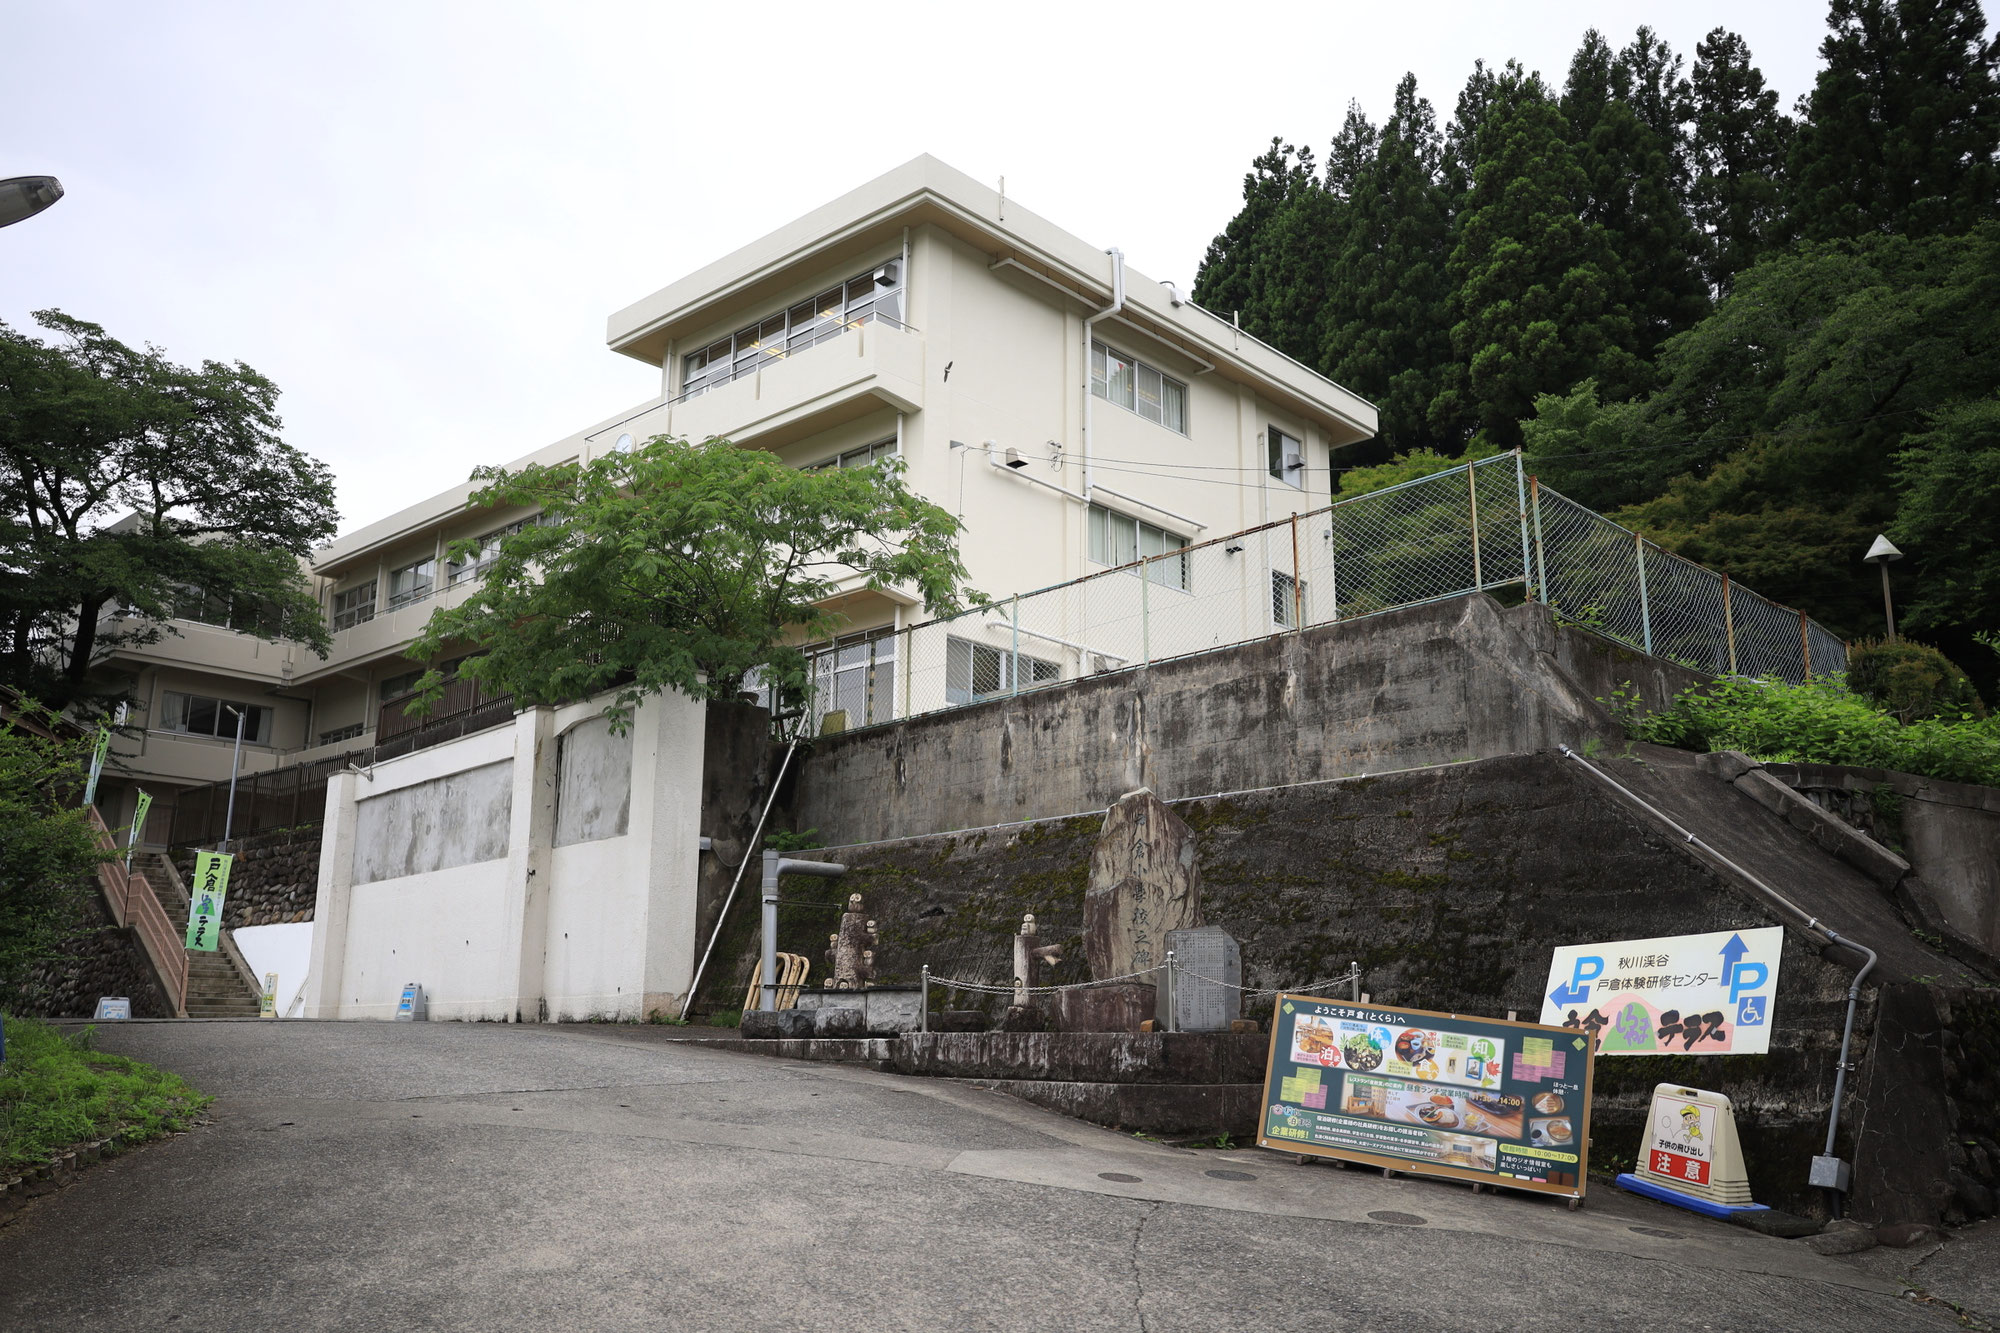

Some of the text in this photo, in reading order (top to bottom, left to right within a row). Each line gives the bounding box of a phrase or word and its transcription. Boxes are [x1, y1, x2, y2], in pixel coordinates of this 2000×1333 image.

[1570, 956, 1605, 993] P
[1618, 954, 1670, 970] 秋川渓谷
[1597, 972, 1719, 992] 戸倉体験研修センター
[1729, 962, 1769, 1004] P
[1658, 1009, 1726, 1051] テラス
[1658, 1139, 1704, 1157] 子供の飛び出し
